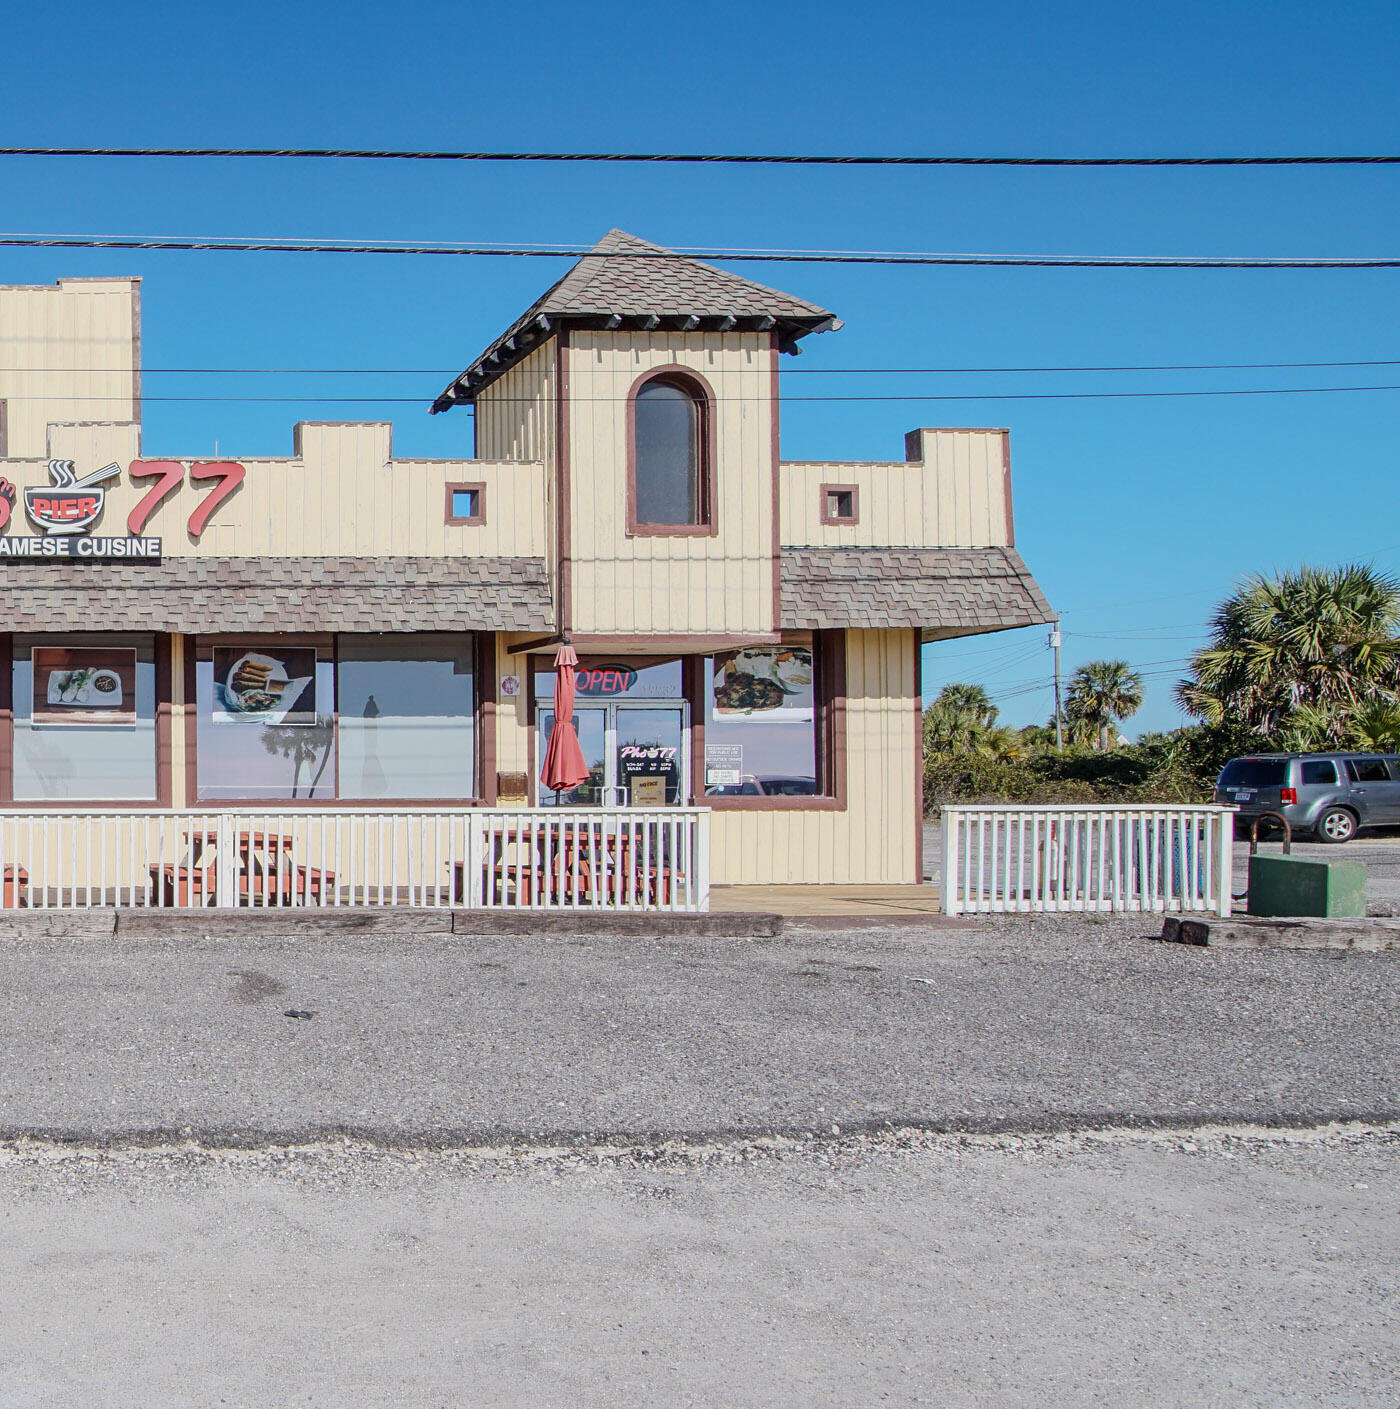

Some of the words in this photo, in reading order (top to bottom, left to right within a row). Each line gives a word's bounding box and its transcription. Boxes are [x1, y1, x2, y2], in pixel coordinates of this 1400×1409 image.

[33, 497, 97, 519] PIER
[127, 459, 246, 536] 77
[77, 538, 161, 557] CUISINE
[575, 669, 630, 692] OPEN
[660, 747, 677, 758] 77
